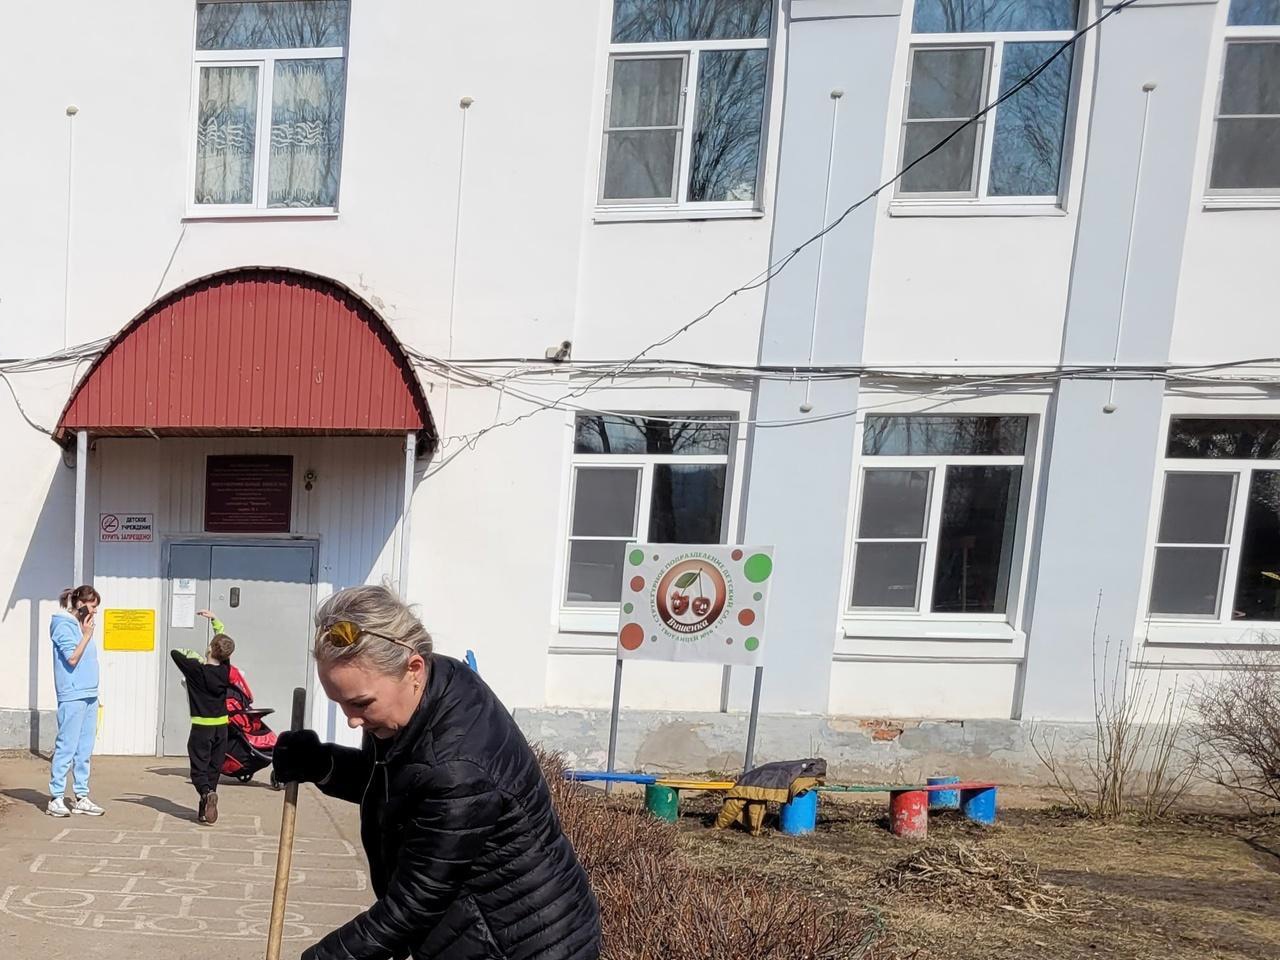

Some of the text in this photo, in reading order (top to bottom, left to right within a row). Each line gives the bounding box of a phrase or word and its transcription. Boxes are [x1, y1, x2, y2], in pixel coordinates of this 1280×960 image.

[723, 568, 733, 608] ДЕТСКИЙ
[667, 618, 709, 633] Вишенка
[717, 610, 730, 626] САД
